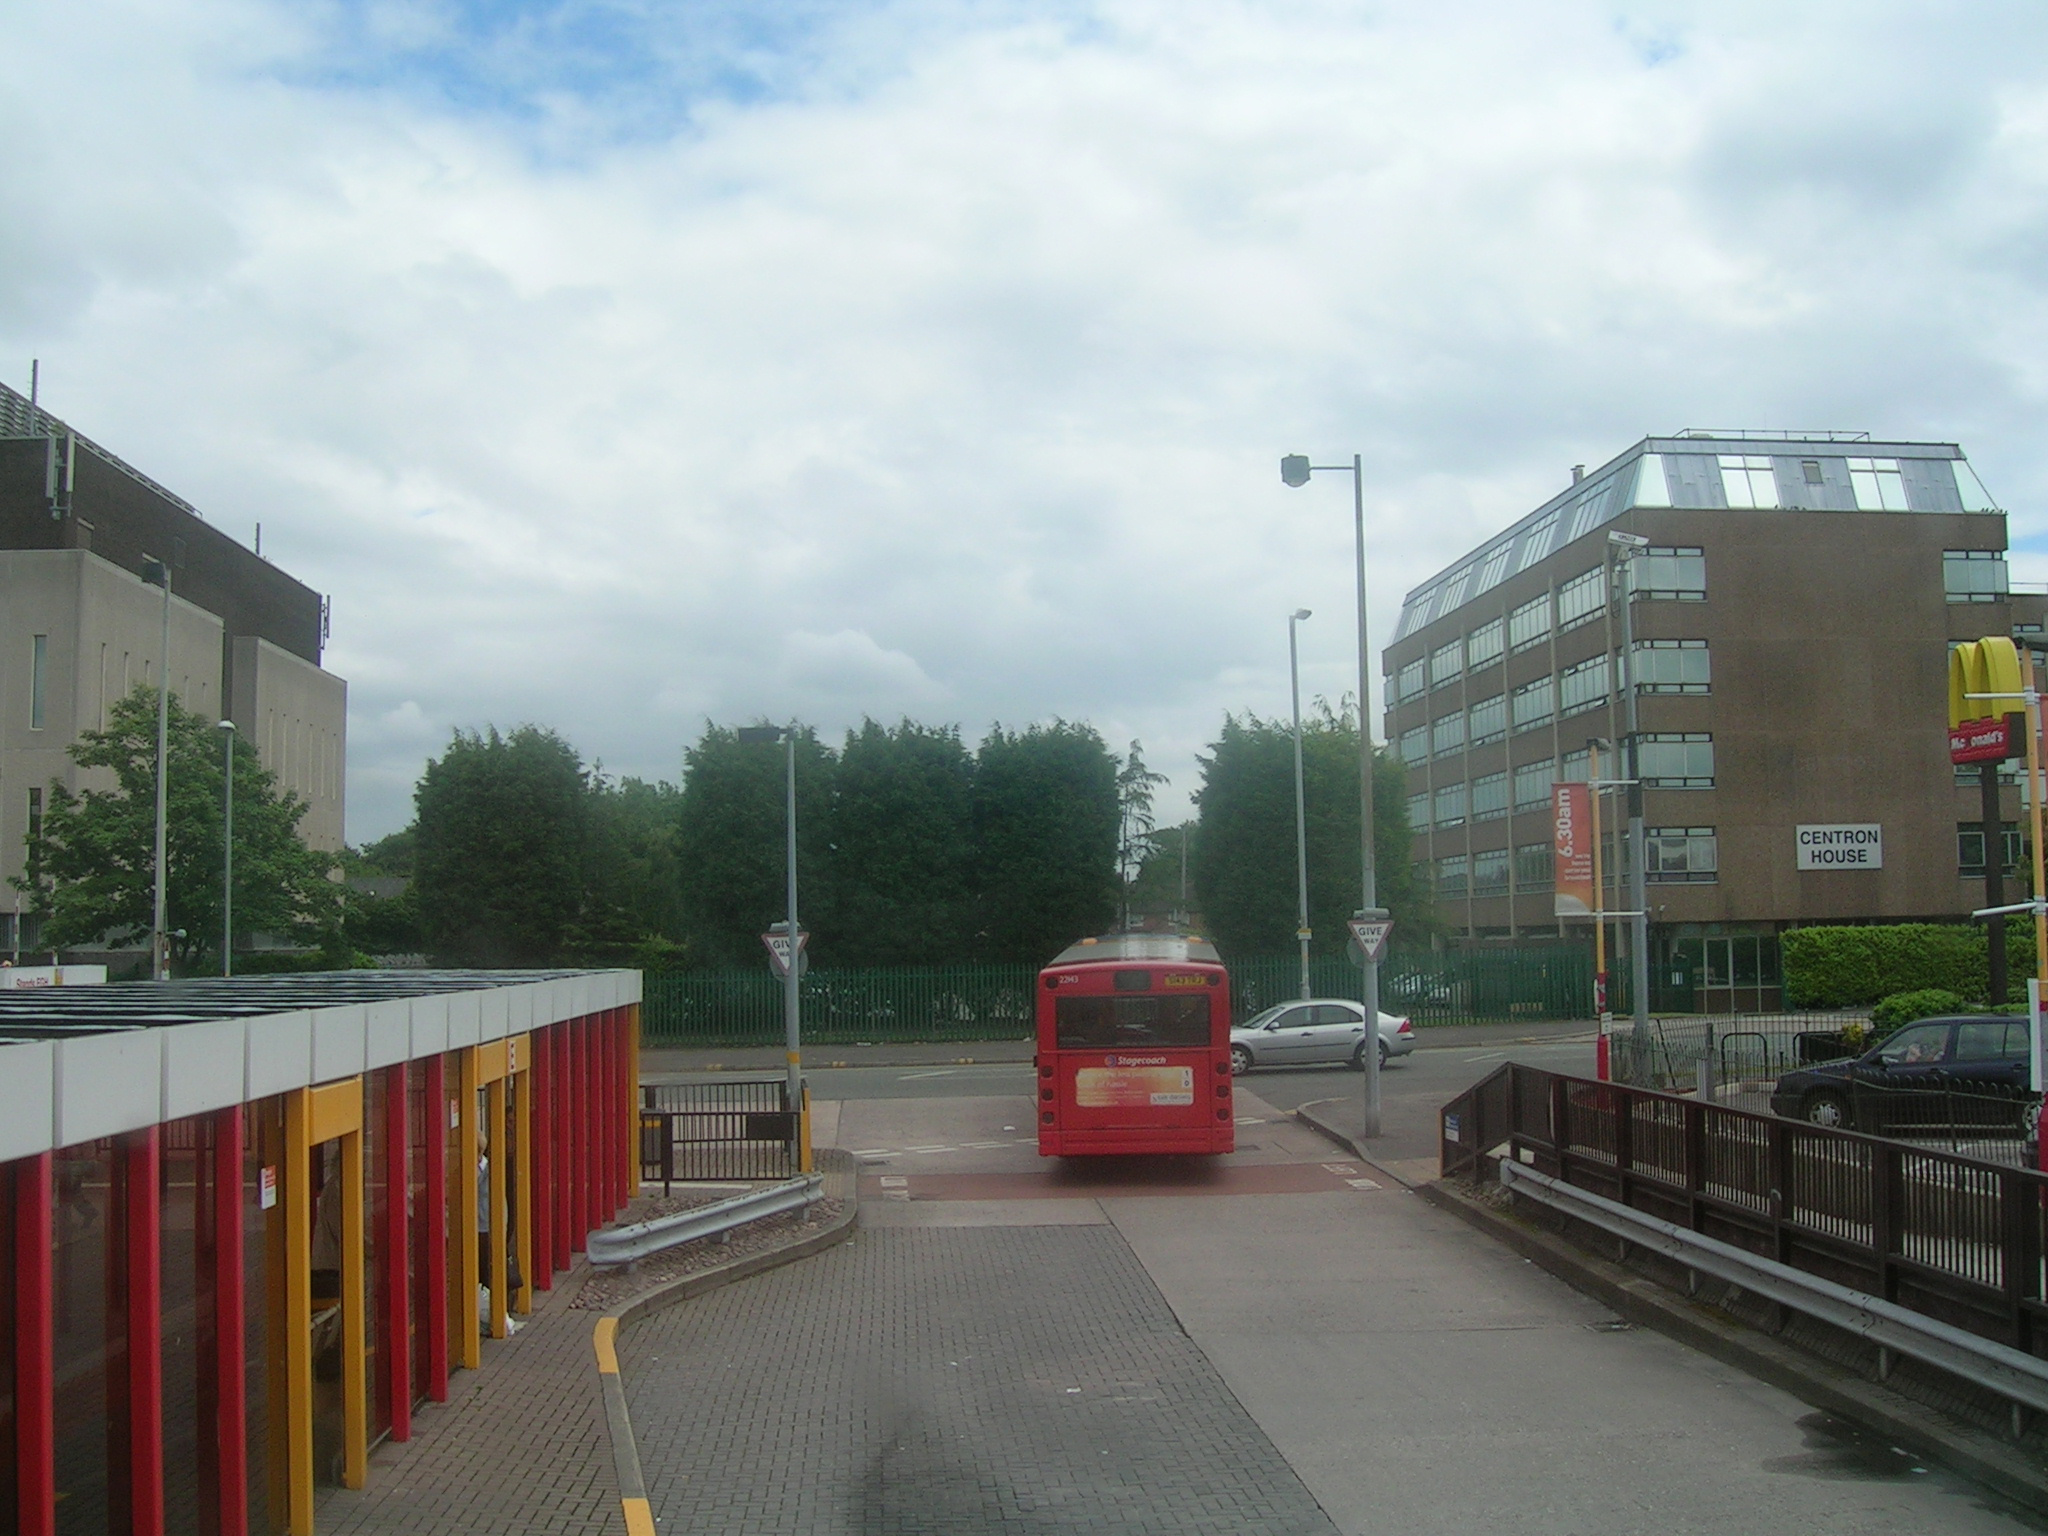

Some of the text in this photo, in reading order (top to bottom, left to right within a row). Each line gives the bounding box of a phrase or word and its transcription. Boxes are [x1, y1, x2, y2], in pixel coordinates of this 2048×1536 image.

[1951, 731, 2003, 750] Mconald's
[1556, 788, 1573, 858] 6.30am
[1800, 830, 1878, 845] CENTRON
[1811, 849, 1867, 863] HOUSE
[1358, 927, 1382, 936] GIVE
[772, 940, 790, 949] GIV
[1117, 1056, 1166, 1067] Stagecoach
